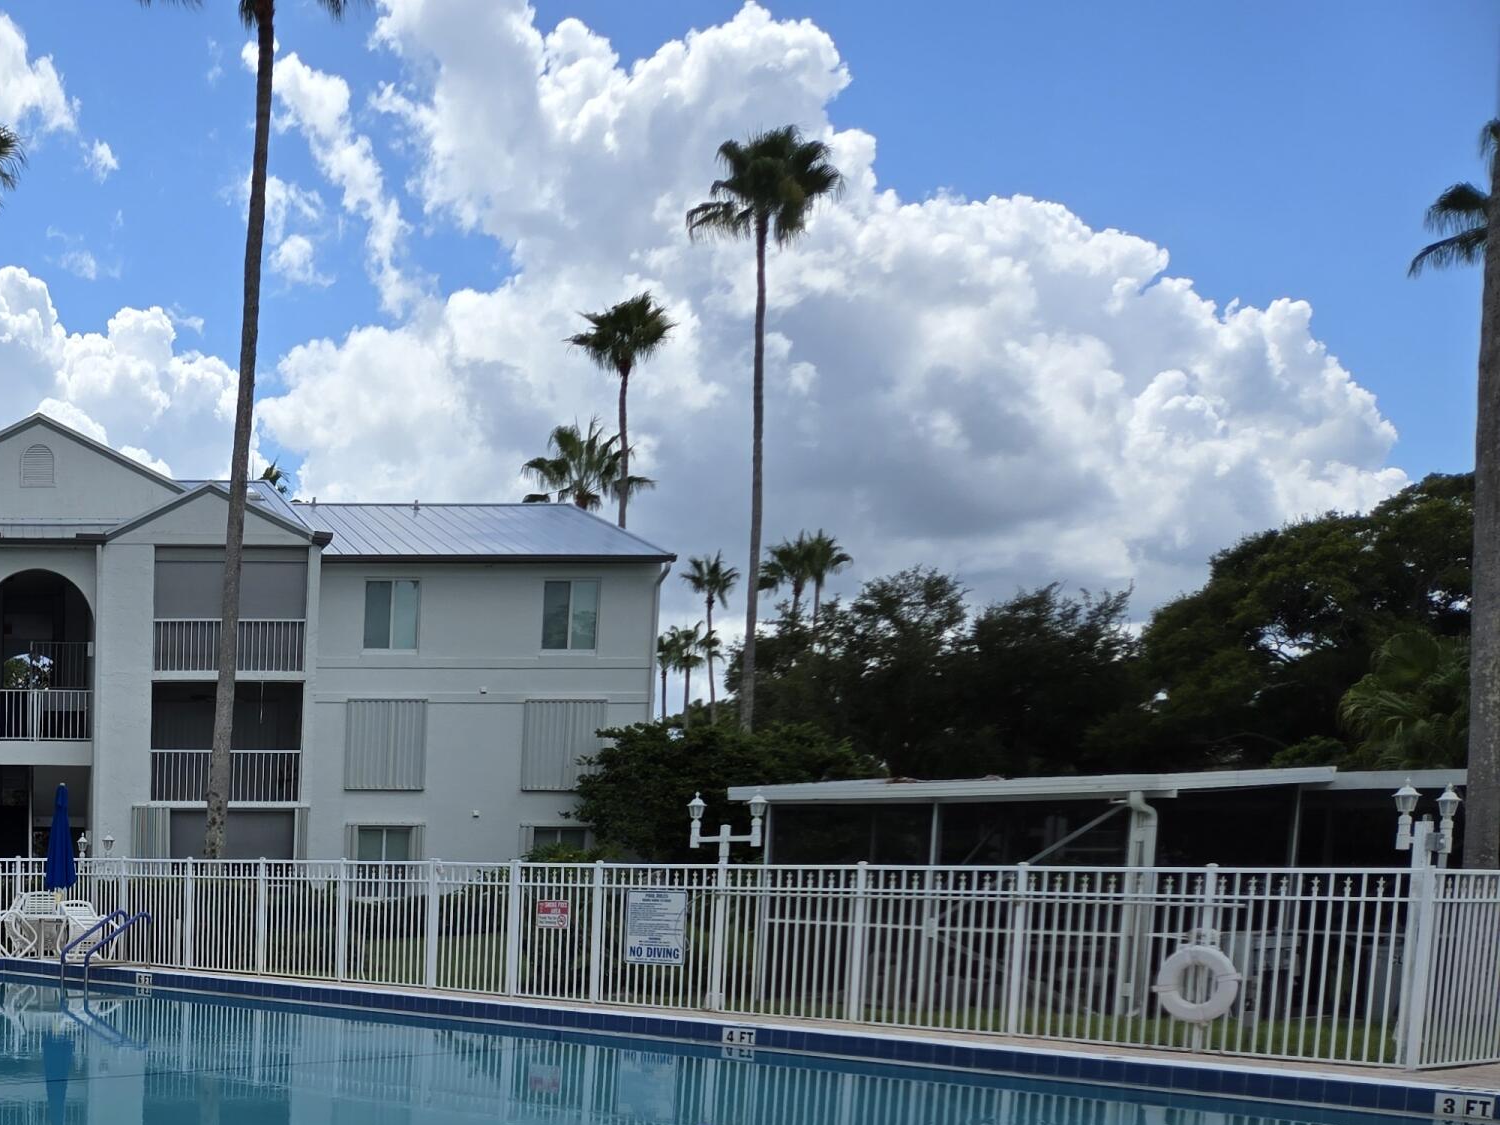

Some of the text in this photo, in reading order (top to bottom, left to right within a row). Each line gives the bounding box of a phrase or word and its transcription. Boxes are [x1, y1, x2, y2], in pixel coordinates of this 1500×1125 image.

[629, 946, 680, 959] NO DIVING
[726, 1030, 754, 1043] 4 FT
[1443, 1098, 1491, 1117] 3 FT
